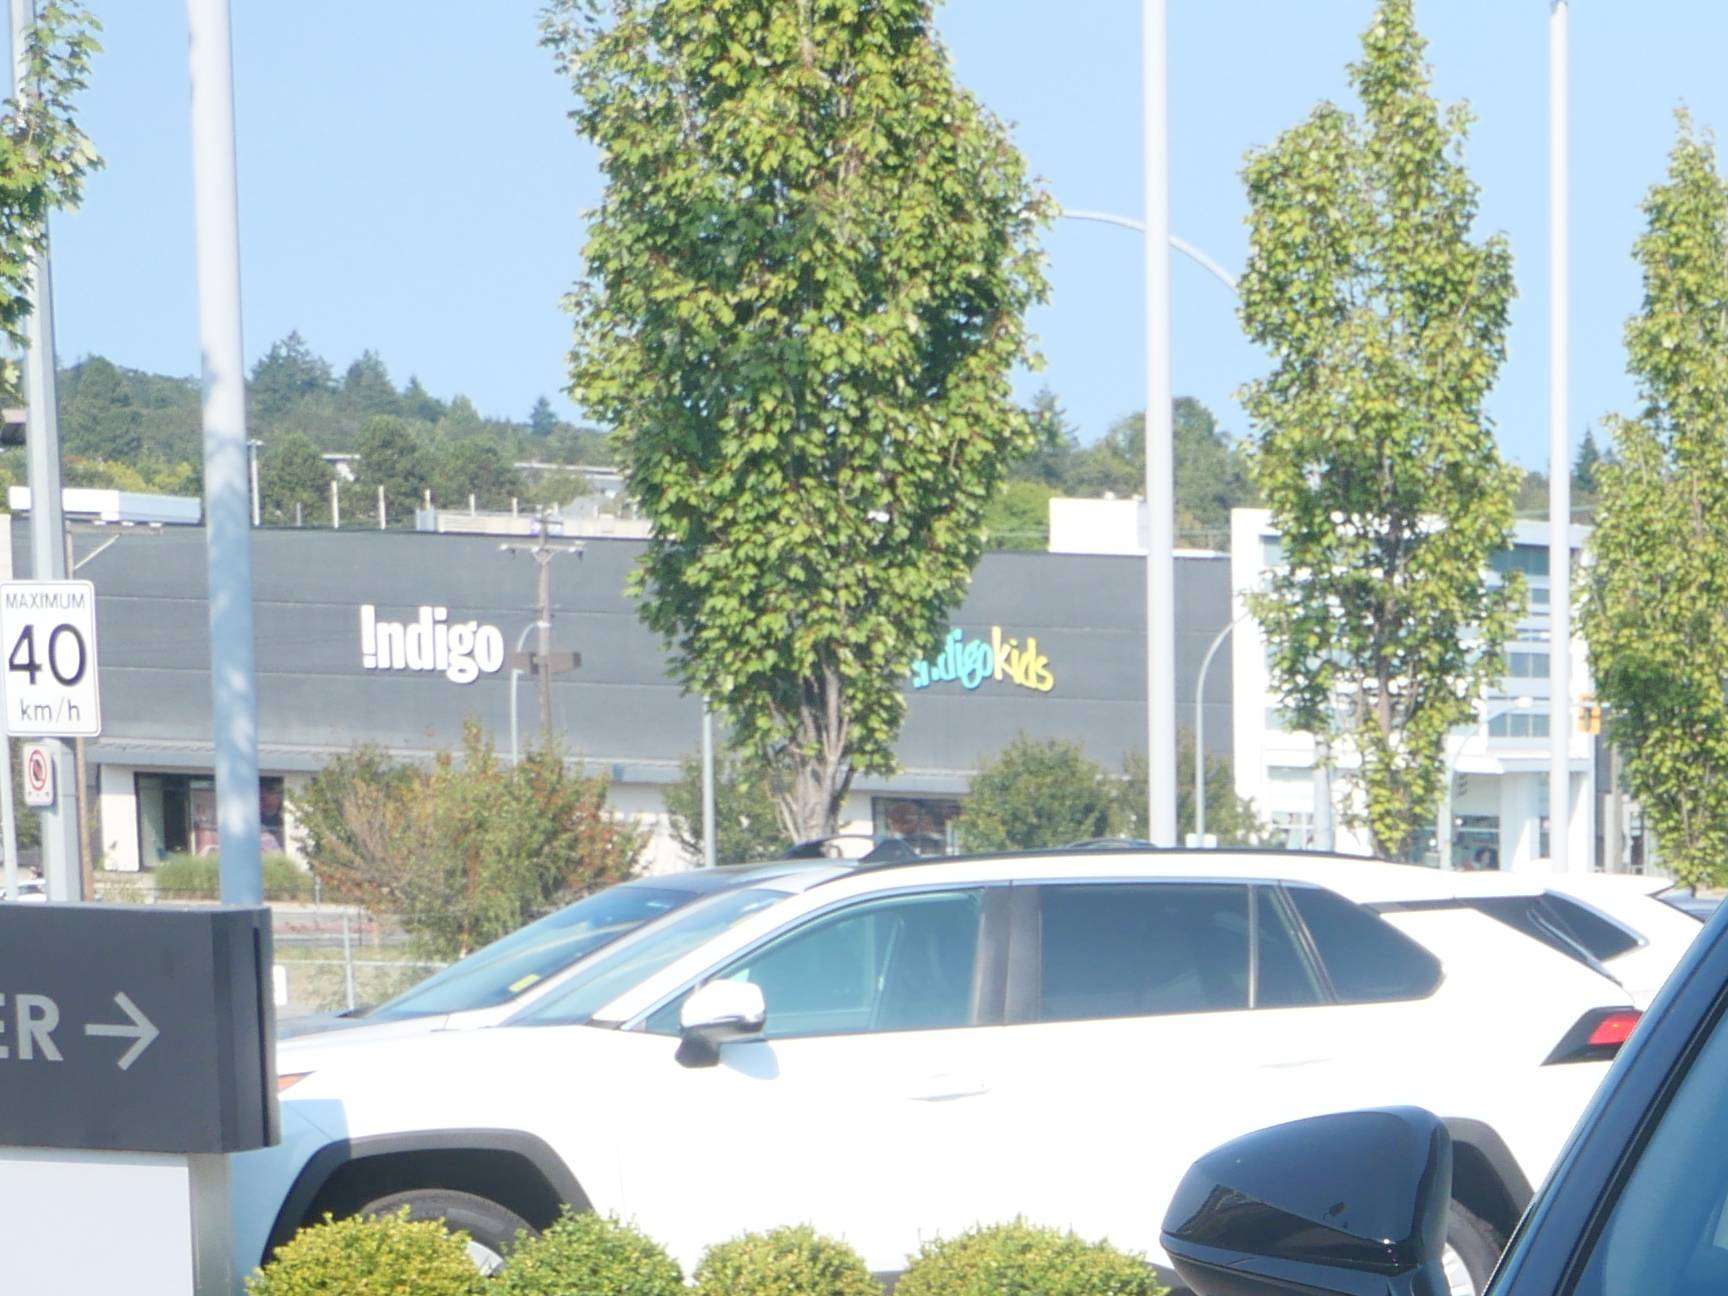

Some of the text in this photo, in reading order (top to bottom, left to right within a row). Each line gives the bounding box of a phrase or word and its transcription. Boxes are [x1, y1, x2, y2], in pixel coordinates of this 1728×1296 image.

[5, 592, 86, 610] MAXIMUM
[8, 623, 87, 687] 40
[20, 697, 81, 724] km/h
